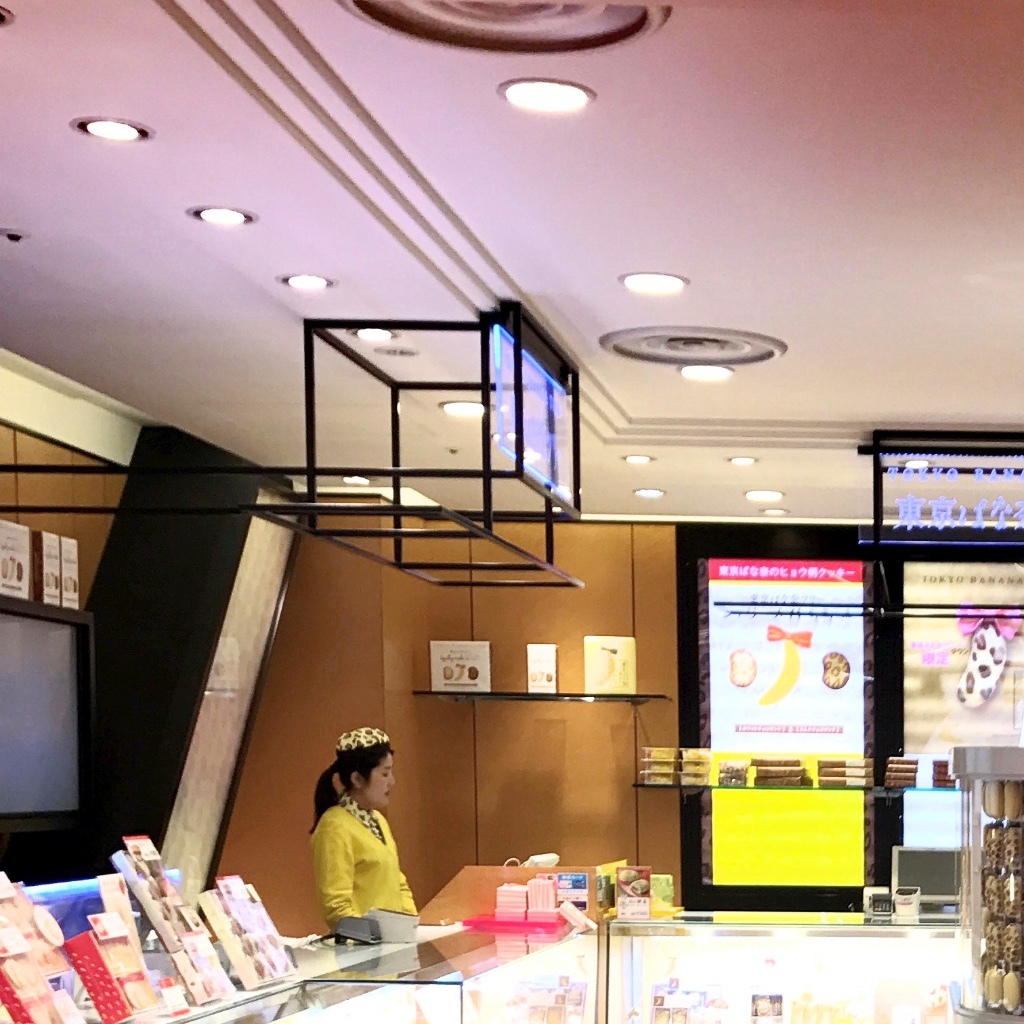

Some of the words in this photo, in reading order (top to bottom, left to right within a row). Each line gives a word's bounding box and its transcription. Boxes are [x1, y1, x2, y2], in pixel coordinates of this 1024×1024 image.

[887, 468, 959, 482] TOKYO
[922, 575, 965, 584] TOKYO
[970, 575, 1024, 584] BANANA
